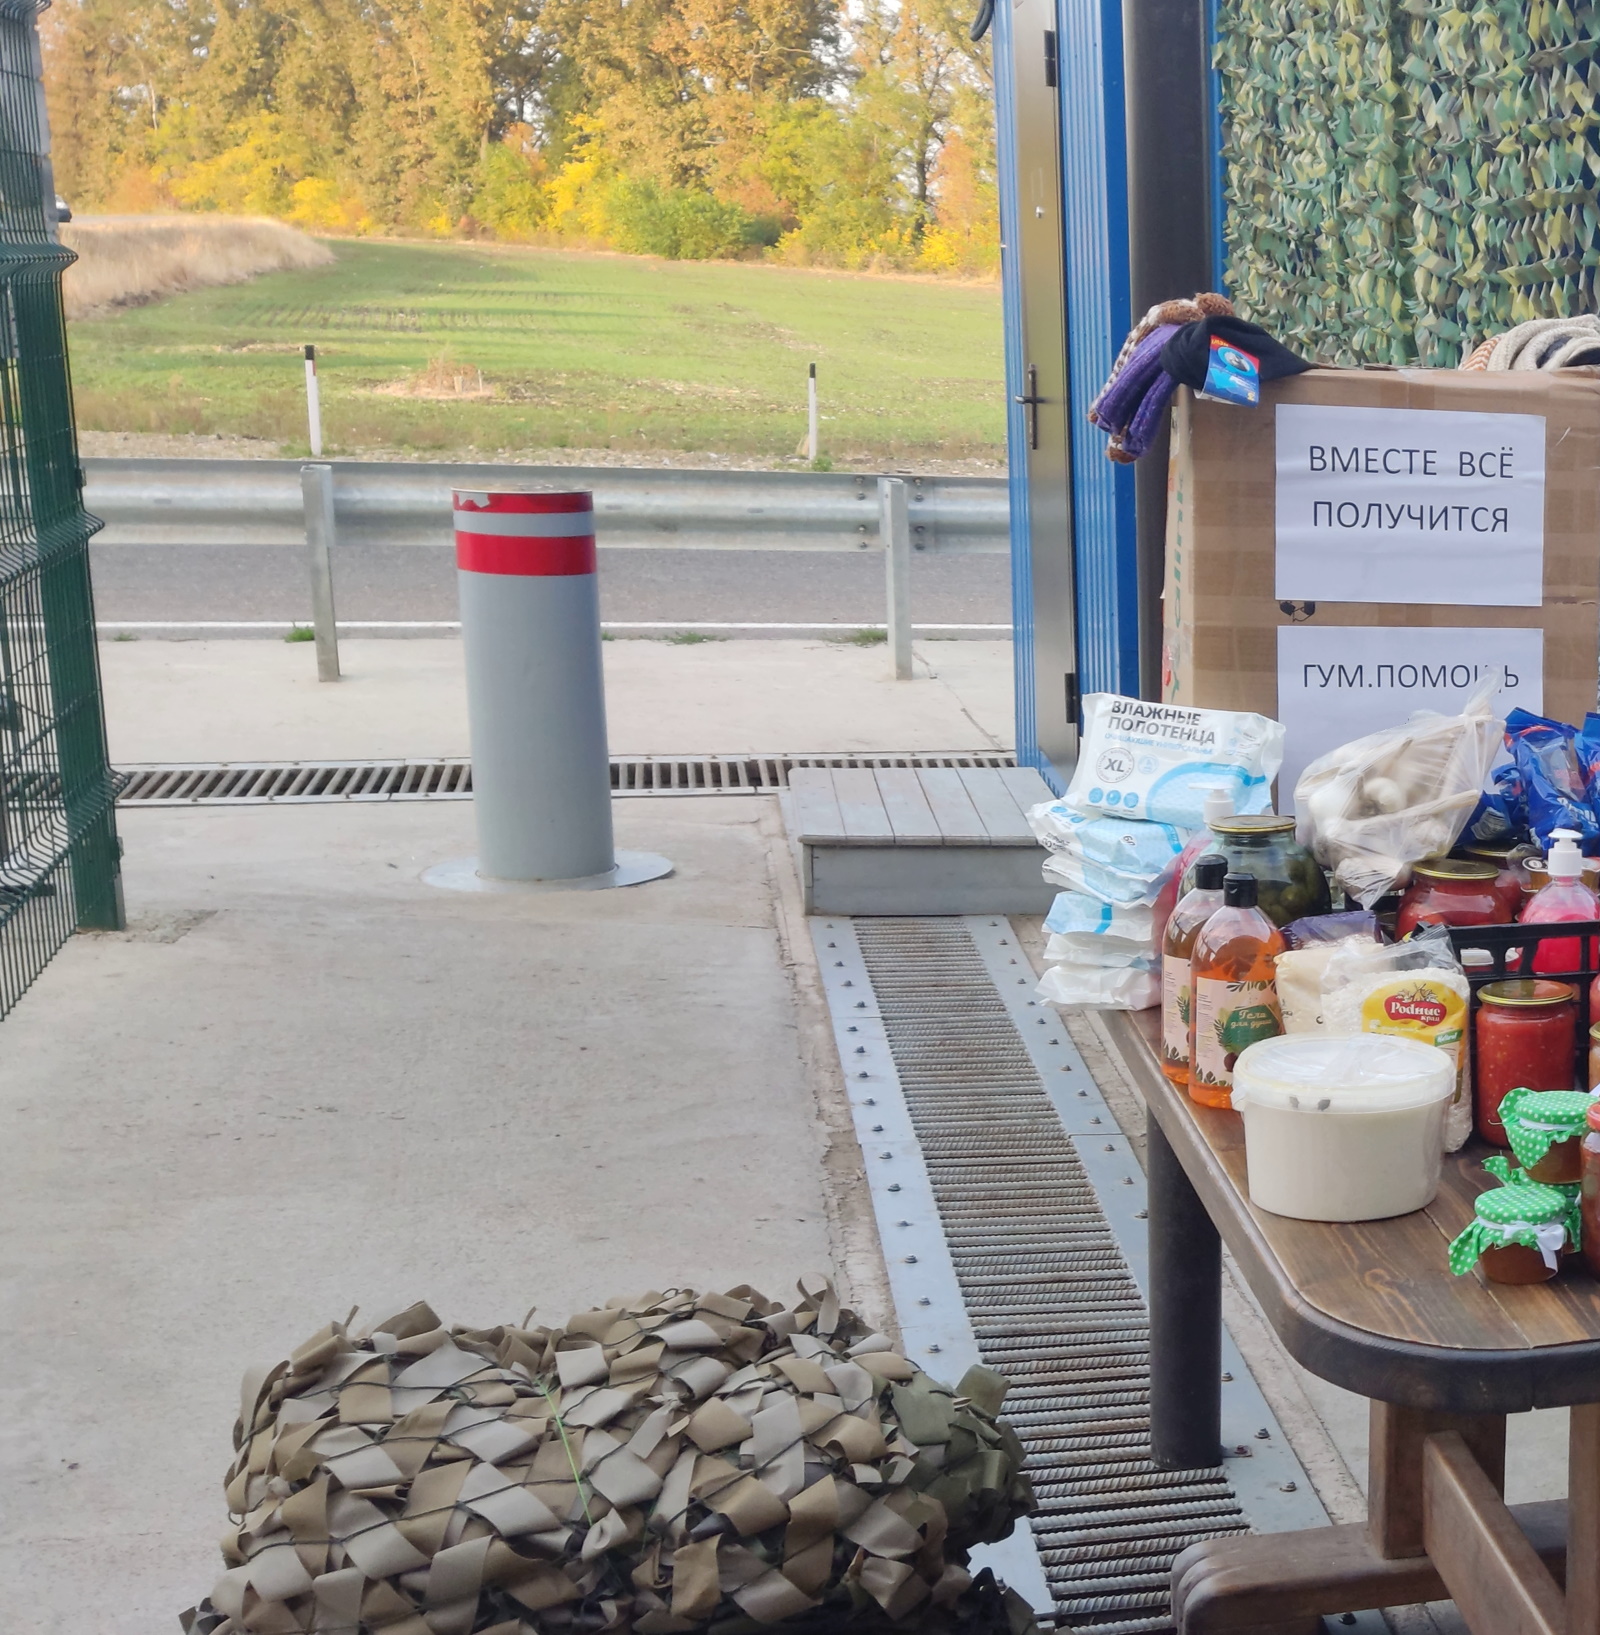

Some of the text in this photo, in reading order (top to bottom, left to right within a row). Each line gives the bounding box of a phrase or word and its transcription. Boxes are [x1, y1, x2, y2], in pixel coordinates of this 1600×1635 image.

[1309, 445, 1514, 479] ВМЕСТЕ ВСЁ
[1313, 501, 1508, 533] ПОЛУЧИТСЯ
[1111, 700, 1202, 726] ВЛАЖНЫЕ
[1107, 716, 1216, 746] ПОЛОТЕНЦА
[1104, 758, 1125, 773] XL
